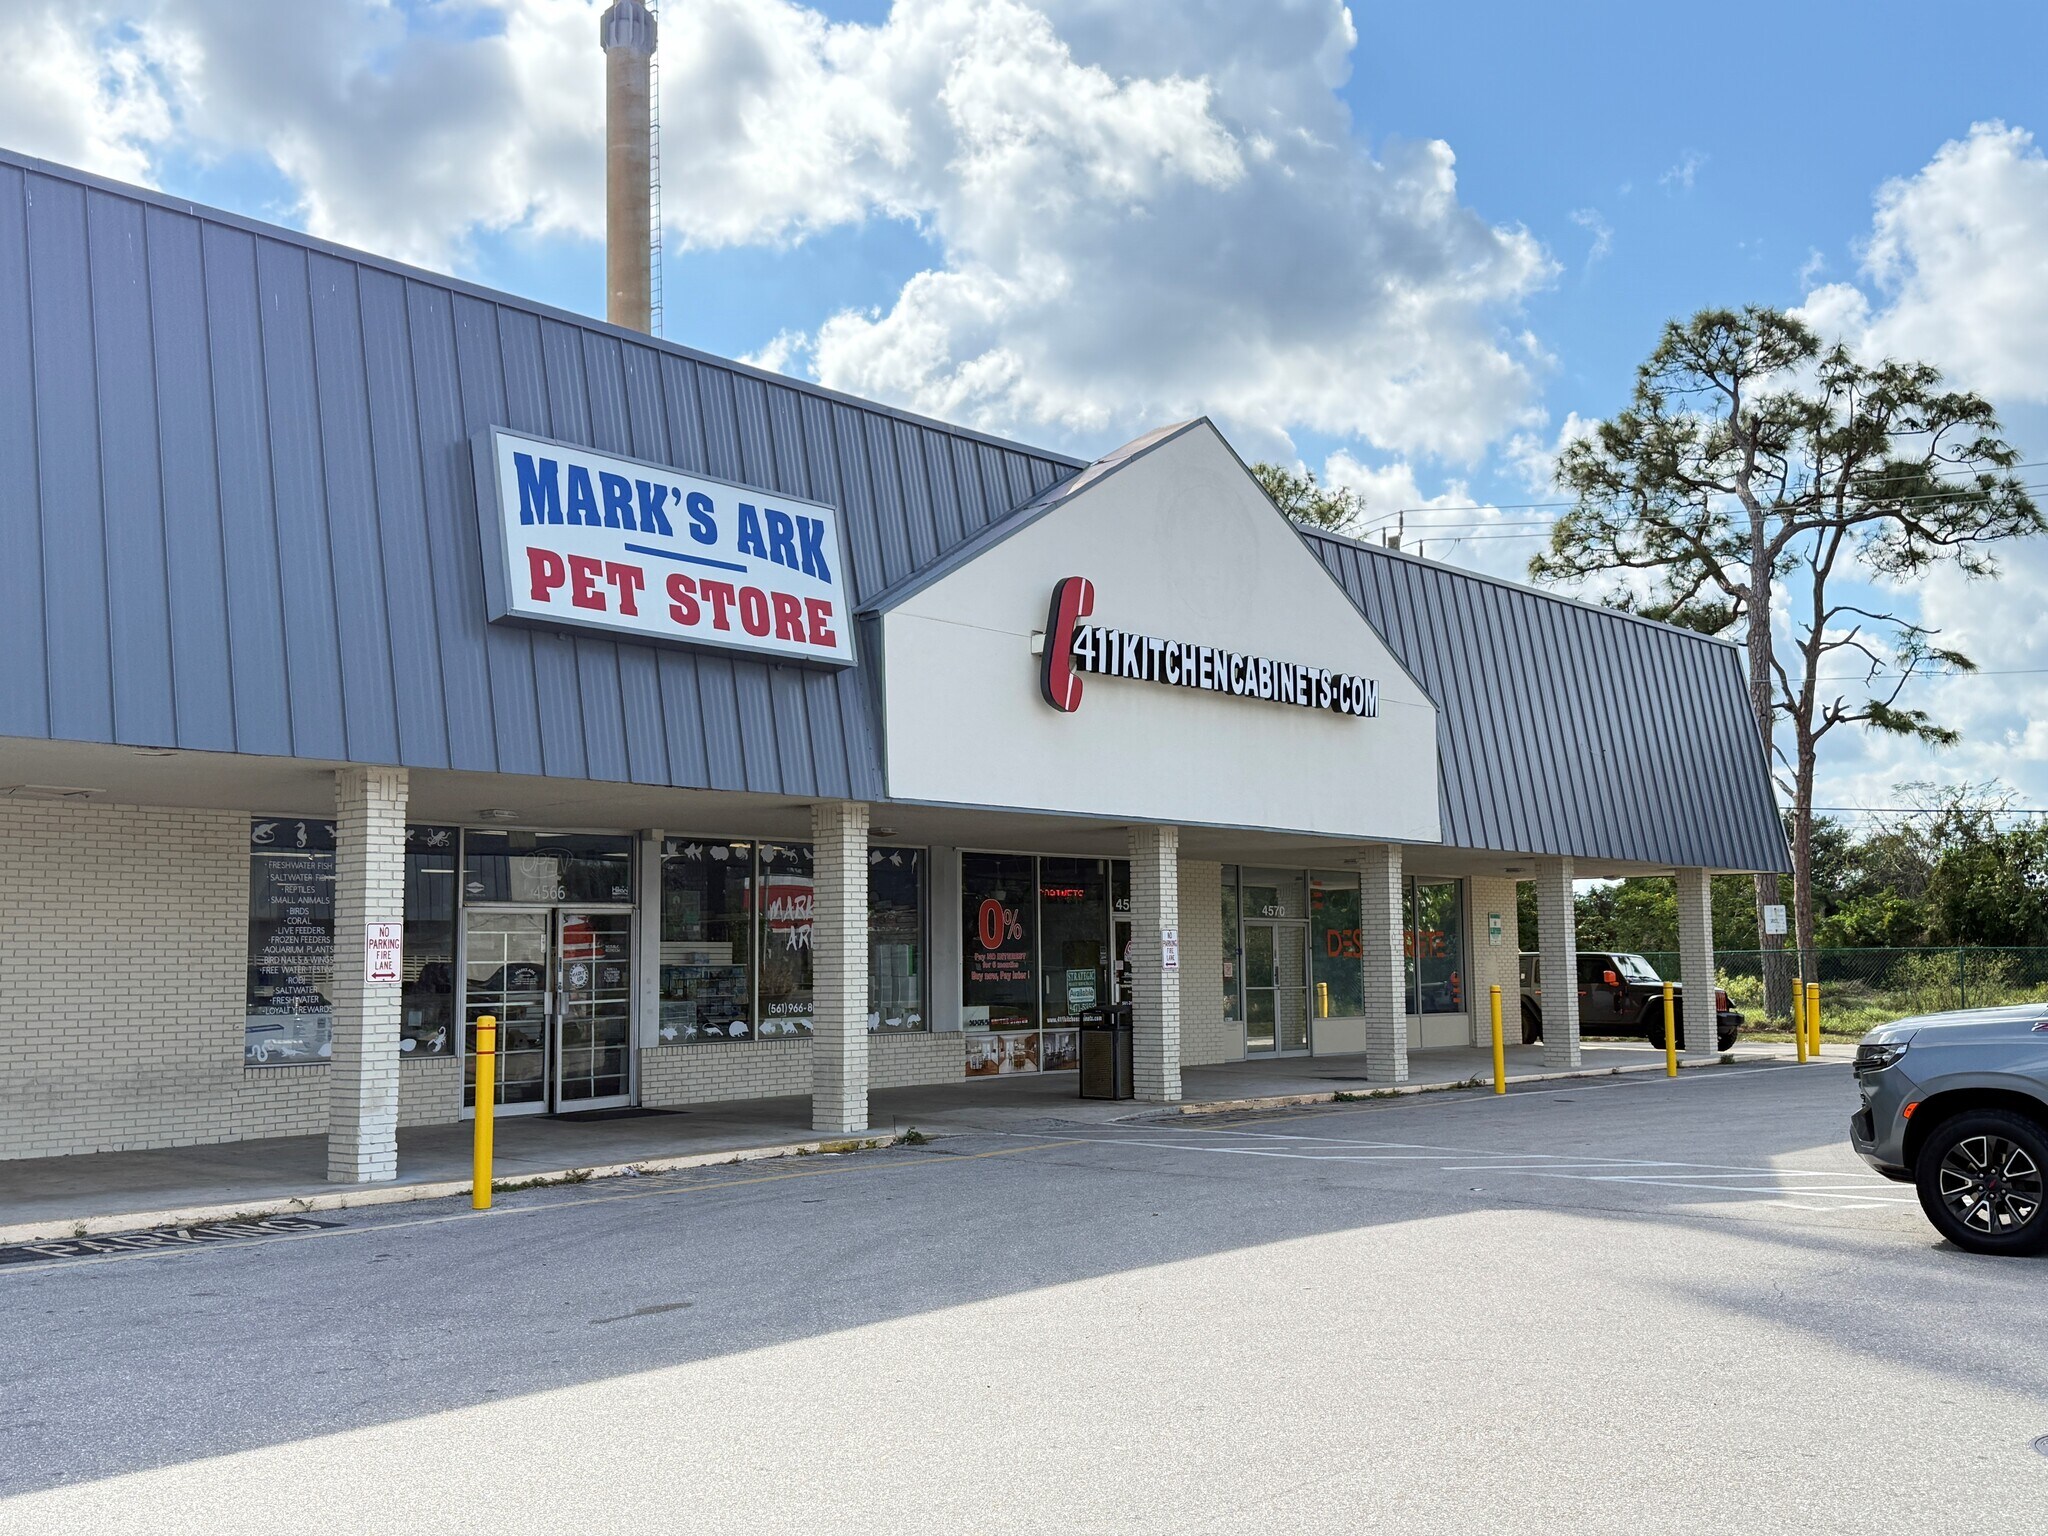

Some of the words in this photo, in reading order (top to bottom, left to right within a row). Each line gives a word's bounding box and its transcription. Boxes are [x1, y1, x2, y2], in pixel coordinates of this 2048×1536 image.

[513, 451, 718, 545] MARK'S
[737, 502, 832, 585] ARK
[526, 546, 645, 617] PET
[666, 573, 837, 648] STORE
[1073, 624, 1379, 717] 411KITCHENCABINETS.COM
[268, 861, 316, 869] FRESHWATER
[317, 862, 333, 870] FISH
[270, 873, 313, 881] SALTWATER
[533, 886, 566, 900] 4566
[271, 896, 296, 904] SMALL
[298, 896, 330, 904] ANIMALS
[1261, 905, 1285, 917] 4570
[287, 917, 312, 925] CORAL
[979, 899, 1022, 949] 0%
[379, 927, 390, 937] NO
[271, 936, 300, 944] FROZEN
[369, 939, 399, 949] PARKING
[306, 945, 334, 953] PLANTS
[264, 956, 281, 964] BIRD
[309, 956, 334, 964] WINGS
[376, 951, 391, 960] FIRE
[375, 961, 392, 970] LANE
[275, 986, 318, 994] SALTWATER
[272, 995, 320, 1004] FRESHWATER
[265, 1006, 297, 1015] LOYALTY
[298, 1005, 334, 1014] REWARDS
[21, 1219, 322, 1258] PARKING
